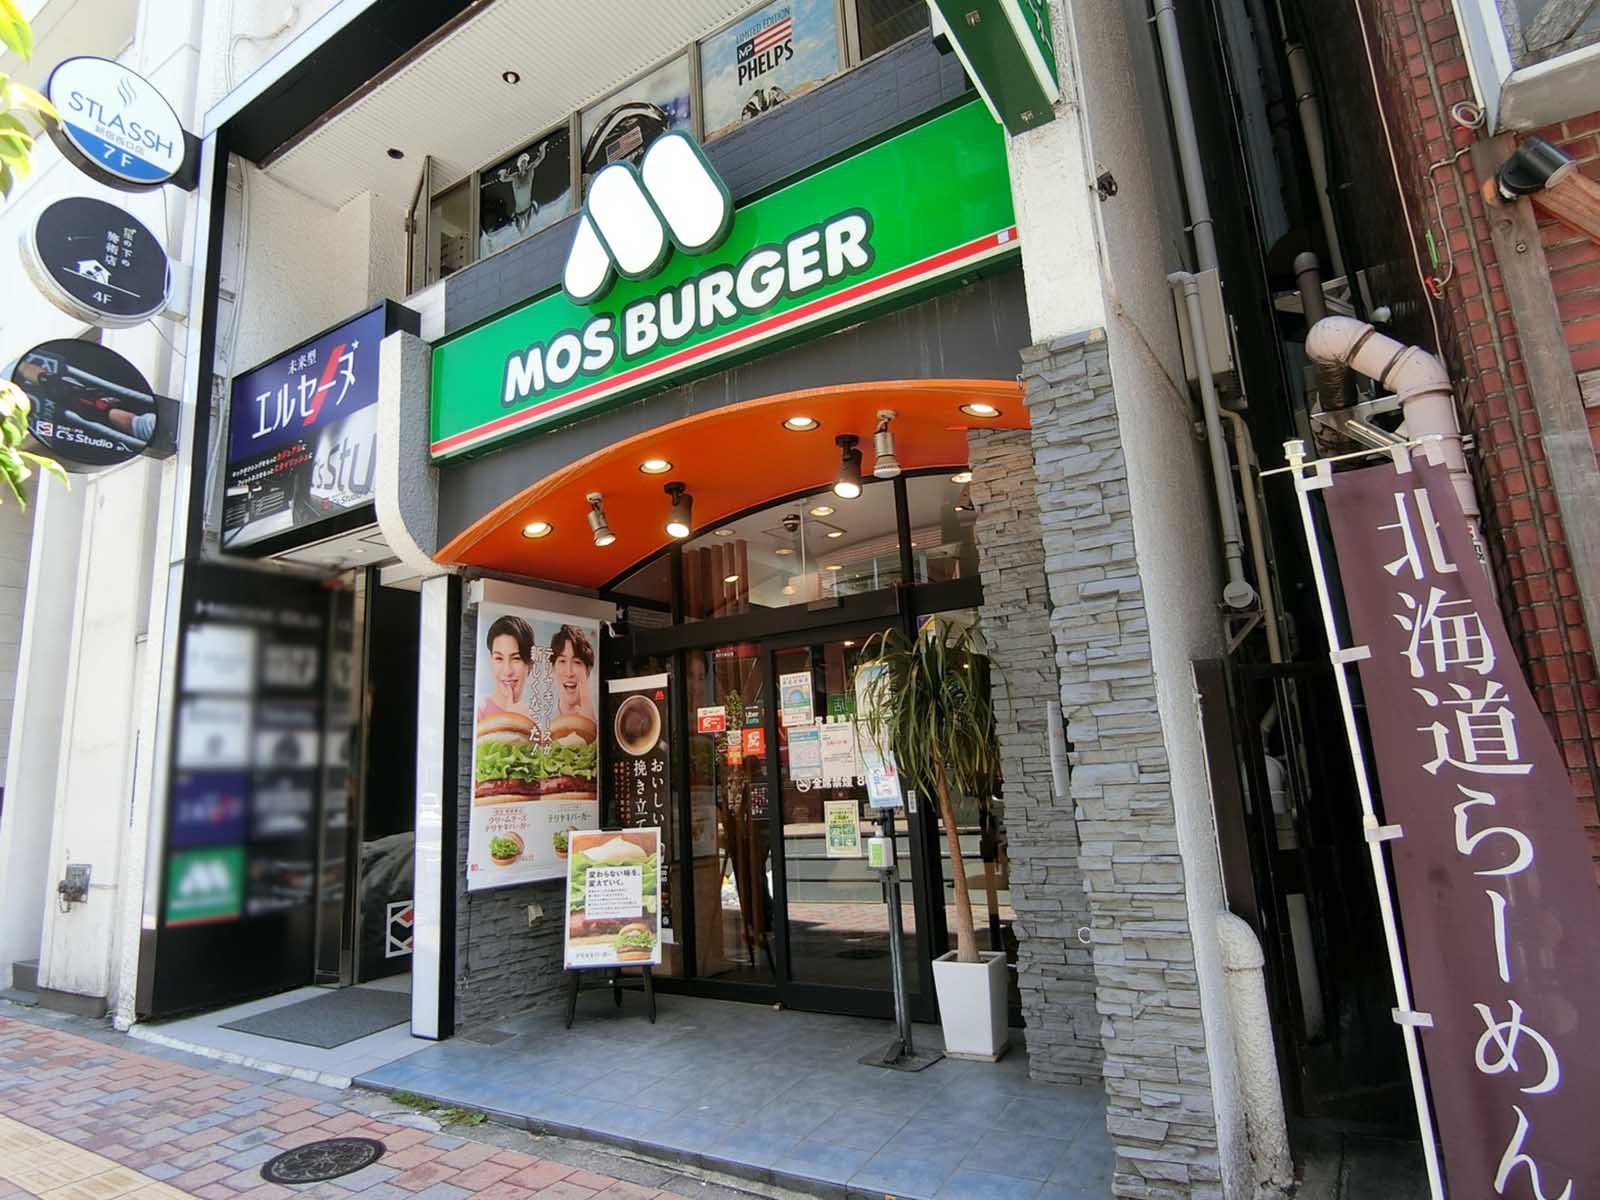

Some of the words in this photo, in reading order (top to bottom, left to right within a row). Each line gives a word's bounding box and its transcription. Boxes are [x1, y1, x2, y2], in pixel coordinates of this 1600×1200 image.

[736, 22, 761, 45] LIMITED
[738, 39, 794, 86] PHELPS
[68, 91, 173, 159] STLASSH
[92, 291, 112, 304] 4F
[504, 317, 615, 402] MOS
[623, 214, 869, 356] BURGER
[287, 348, 317, 375] 未来型
[75, 433, 113, 449] Studio
[650, 758, 665, 826] おいしい
[1376, 487, 1574, 1200] 北海道らーめん
